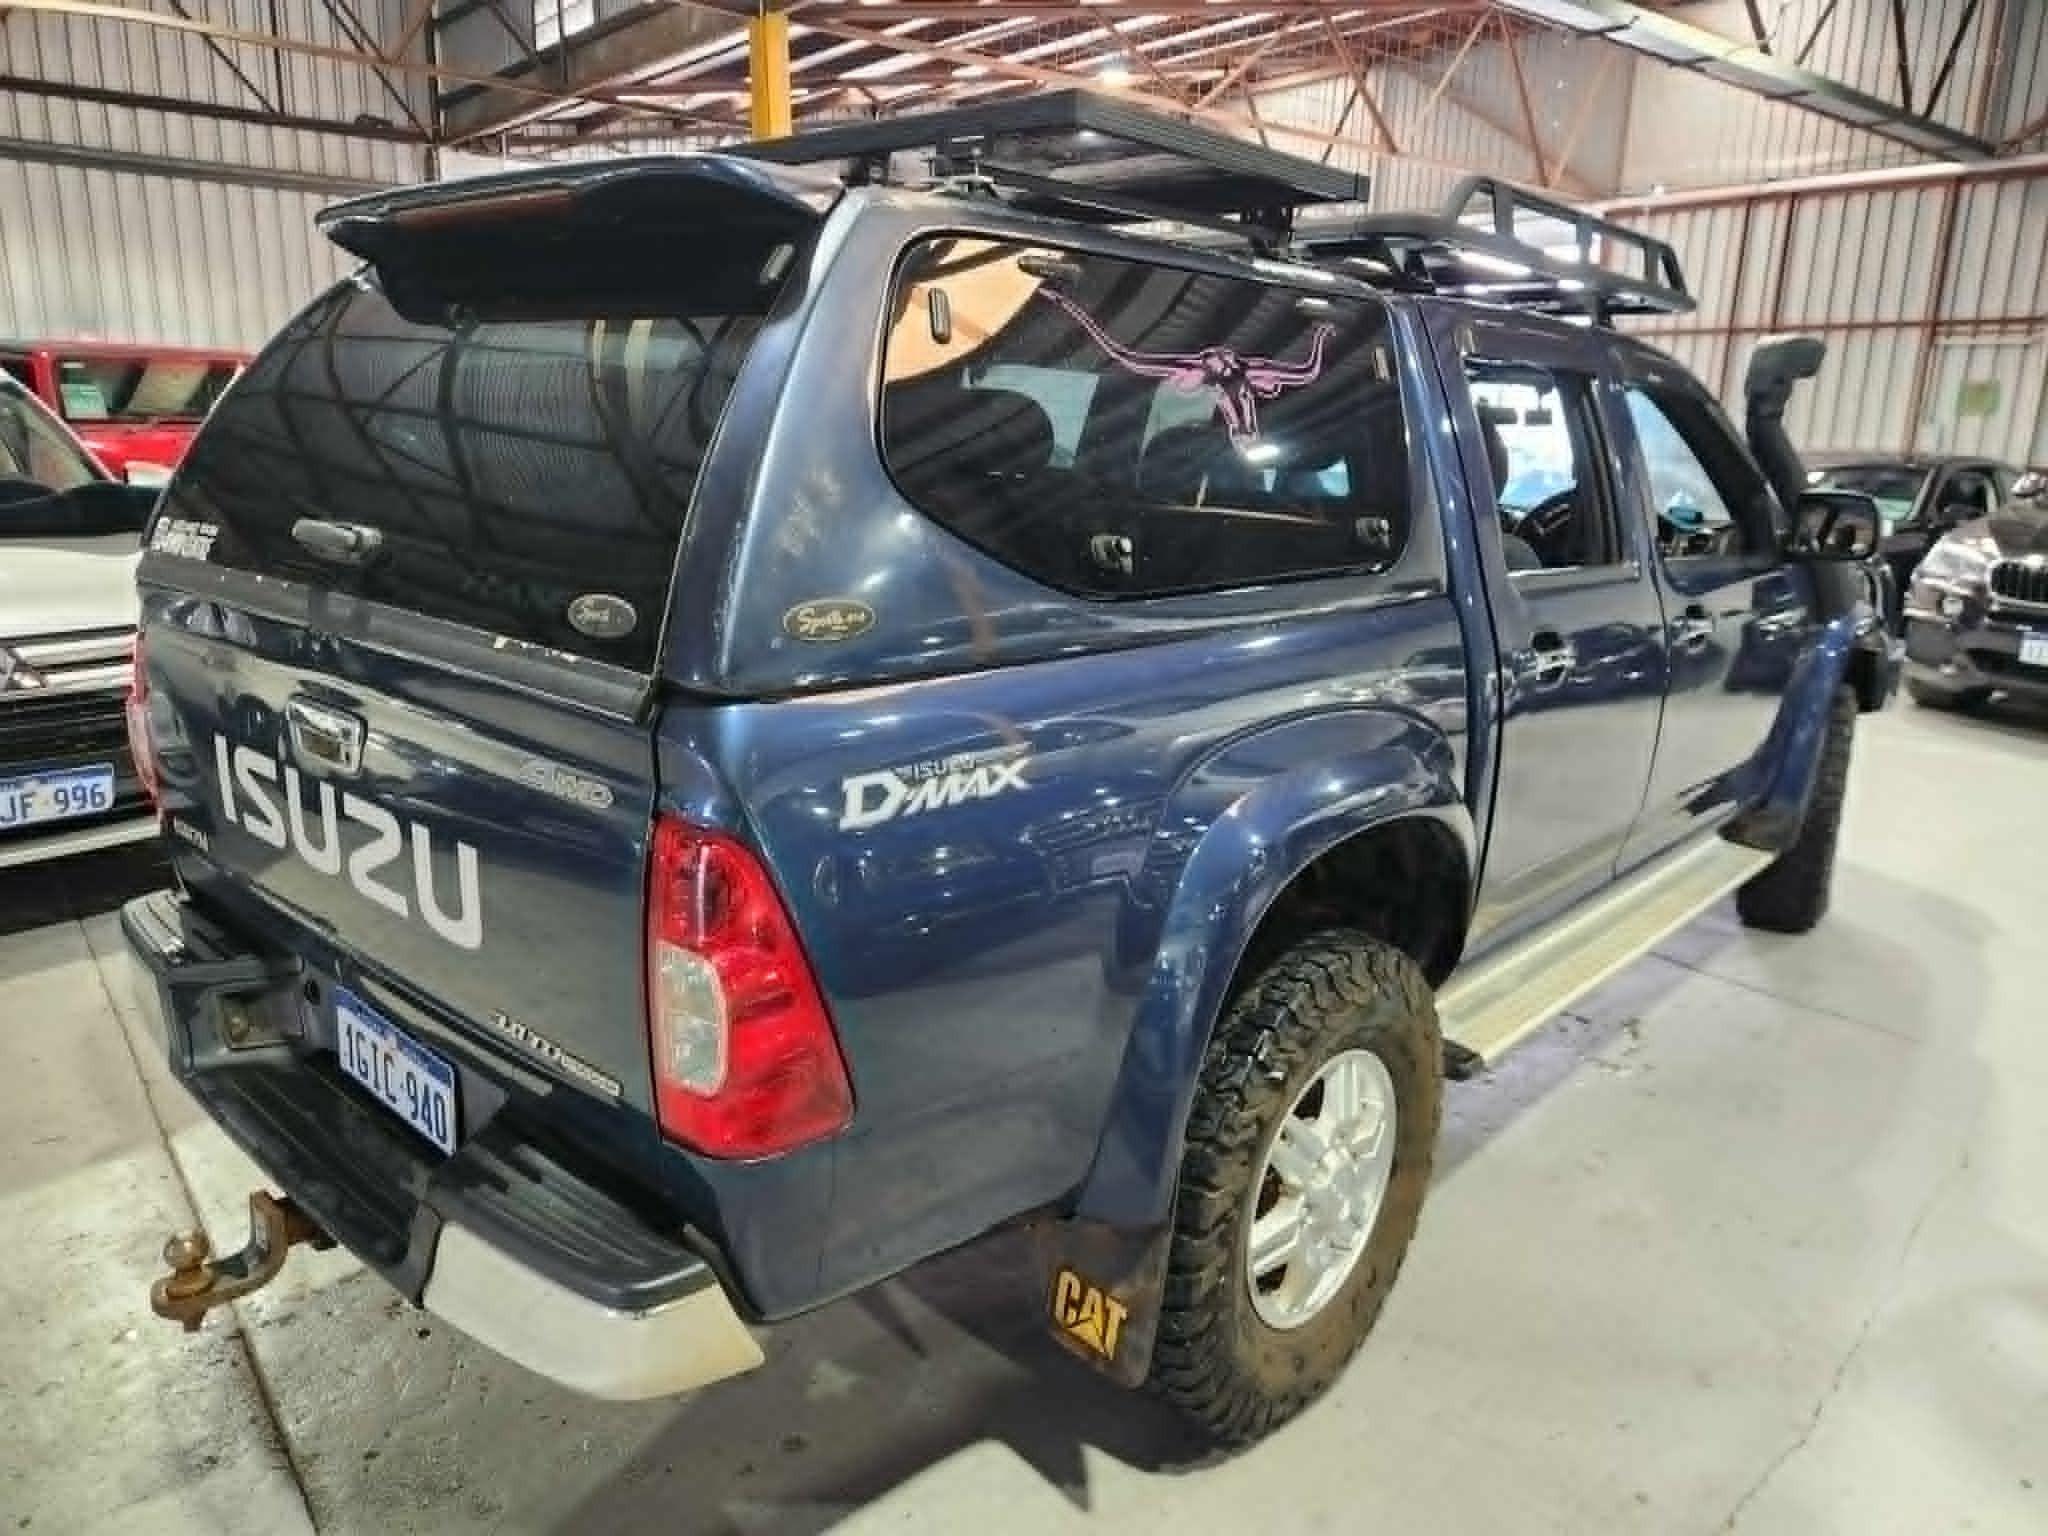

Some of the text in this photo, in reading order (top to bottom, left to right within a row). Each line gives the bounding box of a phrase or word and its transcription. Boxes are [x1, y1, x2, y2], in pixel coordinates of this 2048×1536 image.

[55, 782, 105, 815] 996
[213, 731, 483, 949] ISUZU
[1055, 1271, 1127, 1361] CAT
